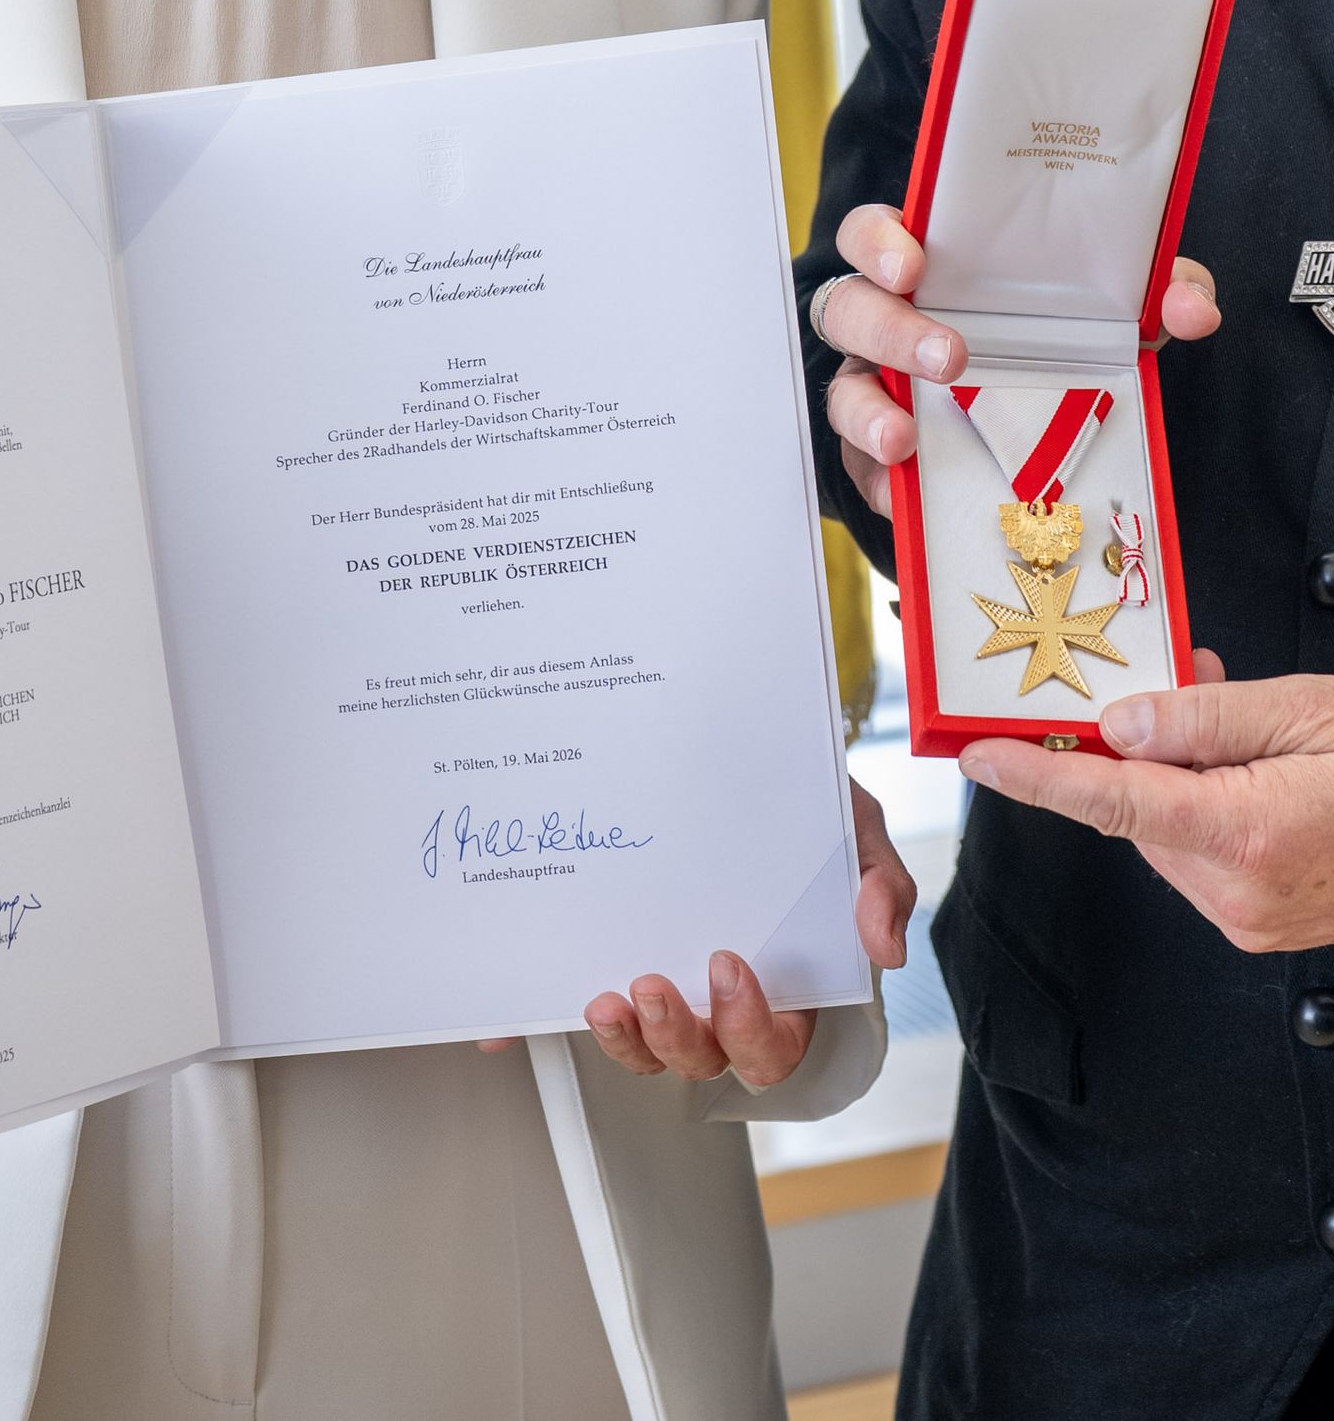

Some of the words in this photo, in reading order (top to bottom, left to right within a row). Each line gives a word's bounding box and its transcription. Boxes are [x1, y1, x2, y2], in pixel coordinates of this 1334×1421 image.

[1031, 121, 1101, 137] VICTORIA
[1032, 133, 1099, 148] AWARDS
[1006, 147, 1119, 166] MEISTERHANDWERK
[1044, 160, 1075, 171] WIEN
[362, 256, 399, 278] Die
[403, 242, 543, 274] Landeshauptfrau
[373, 298, 405, 310] von
[408, 273, 547, 306] Niederösterreich
[446, 357, 487, 371] Herrn
[419, 371, 519, 395] Kommerzialrat
[402, 395, 471, 415] Ferdinand
[473, 393, 490, 407] O.
[492, 389, 541, 405] Fischer
[327, 426, 385, 443] Gründer
[388, 423, 411, 436] der
[413, 411, 529, 434] Harley-Davidson
[531, 401, 620, 420] Charity-Tour
[275, 451, 334, 471] Sprecher
[336, 448, 360, 462] des
[362, 438, 448, 459] 2Radhandels
[450, 435, 473, 449] der
[475, 423, 604, 446] Wirtschaftskammer
[606, 412, 676, 432] Österreich
[310, 514, 336, 527] Der
[338, 510, 371, 524] Herr
[373, 497, 485, 520] Bundespräsident
[486, 494, 509, 508] hat
[511, 491, 531, 505] dir
[534, 488, 557, 503] mit
[559, 479, 654, 500] Entschließung
[428, 522, 459, 533] vom
[458, 515, 480, 531] 28.
[480, 513, 509, 528] Mai
[509, 509, 540, 525] 2025
[346, 557, 380, 573] DAS
[387, 547, 467, 569] GOLDENE
[472, 529, 636, 560] VERDIENSTZEICHEN
[8, 569, 86, 604] FISCHER
[378, 577, 414, 593] DER
[419, 567, 499, 589] REPUBLIK
[505, 556, 608, 580] ÖSTERREICH
[460, 598, 525, 615] verliehen.
[365, 678, 382, 691] Es
[384, 675, 417, 691] freut
[419, 670, 452, 686] mich
[455, 668, 487, 683] sehr,
[490, 665, 510, 679] dir
[512, 665, 536, 676] aus
[538, 660, 586, 674] diesem
[589, 653, 635, 669] Anlass
[338, 699, 378, 714] meine
[380, 692, 461, 710] herzlichsten
[463, 680, 561, 701] Glückwünsche
[563, 671, 666, 691] auszusprechen.
[433, 761, 451, 774] St.
[453, 757, 499, 772] Pölten,
[502, 754, 521, 767] 19.
[523, 750, 550, 765] Mai
[551, 747, 583, 762] 2026
[461, 862, 576, 884] Landeshauptfrau
